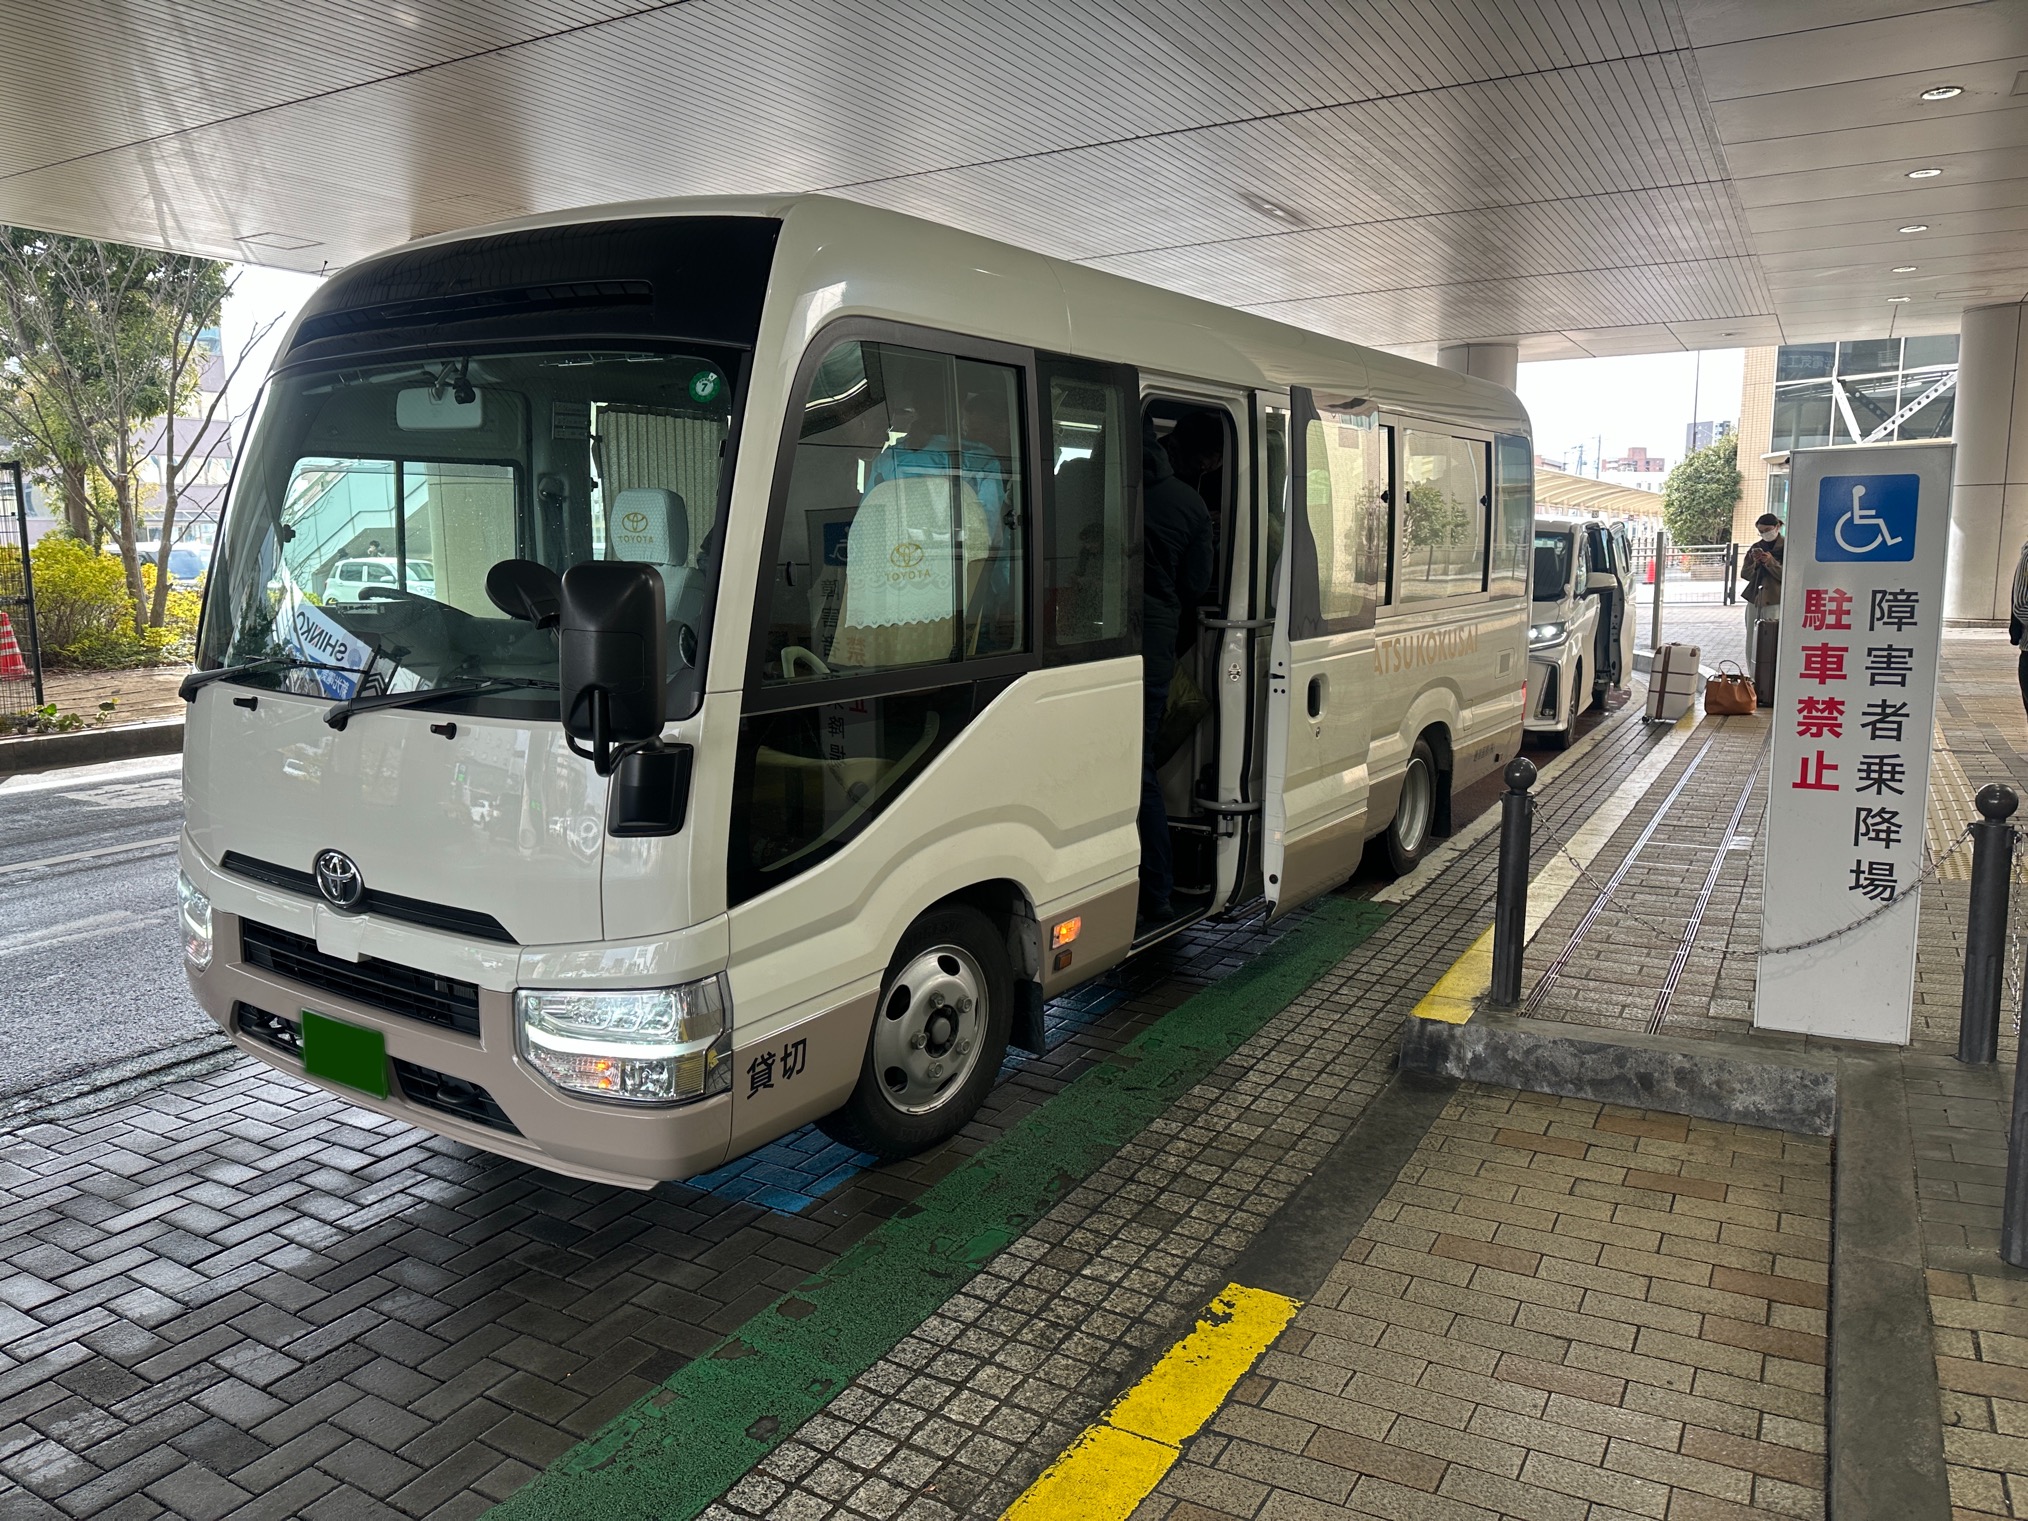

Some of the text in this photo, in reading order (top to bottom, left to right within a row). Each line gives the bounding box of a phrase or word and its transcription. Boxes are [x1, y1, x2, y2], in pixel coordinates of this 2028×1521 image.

[701, 383, 708, 392] 7
[617, 535, 654, 544] TOYOTA
[885, 569, 931, 582] TOYOTA
[1792, 588, 1853, 792] 駐車禁止
[1848, 588, 1920, 902] 障害者乗降場
[746, 1037, 807, 1100] 貸切
